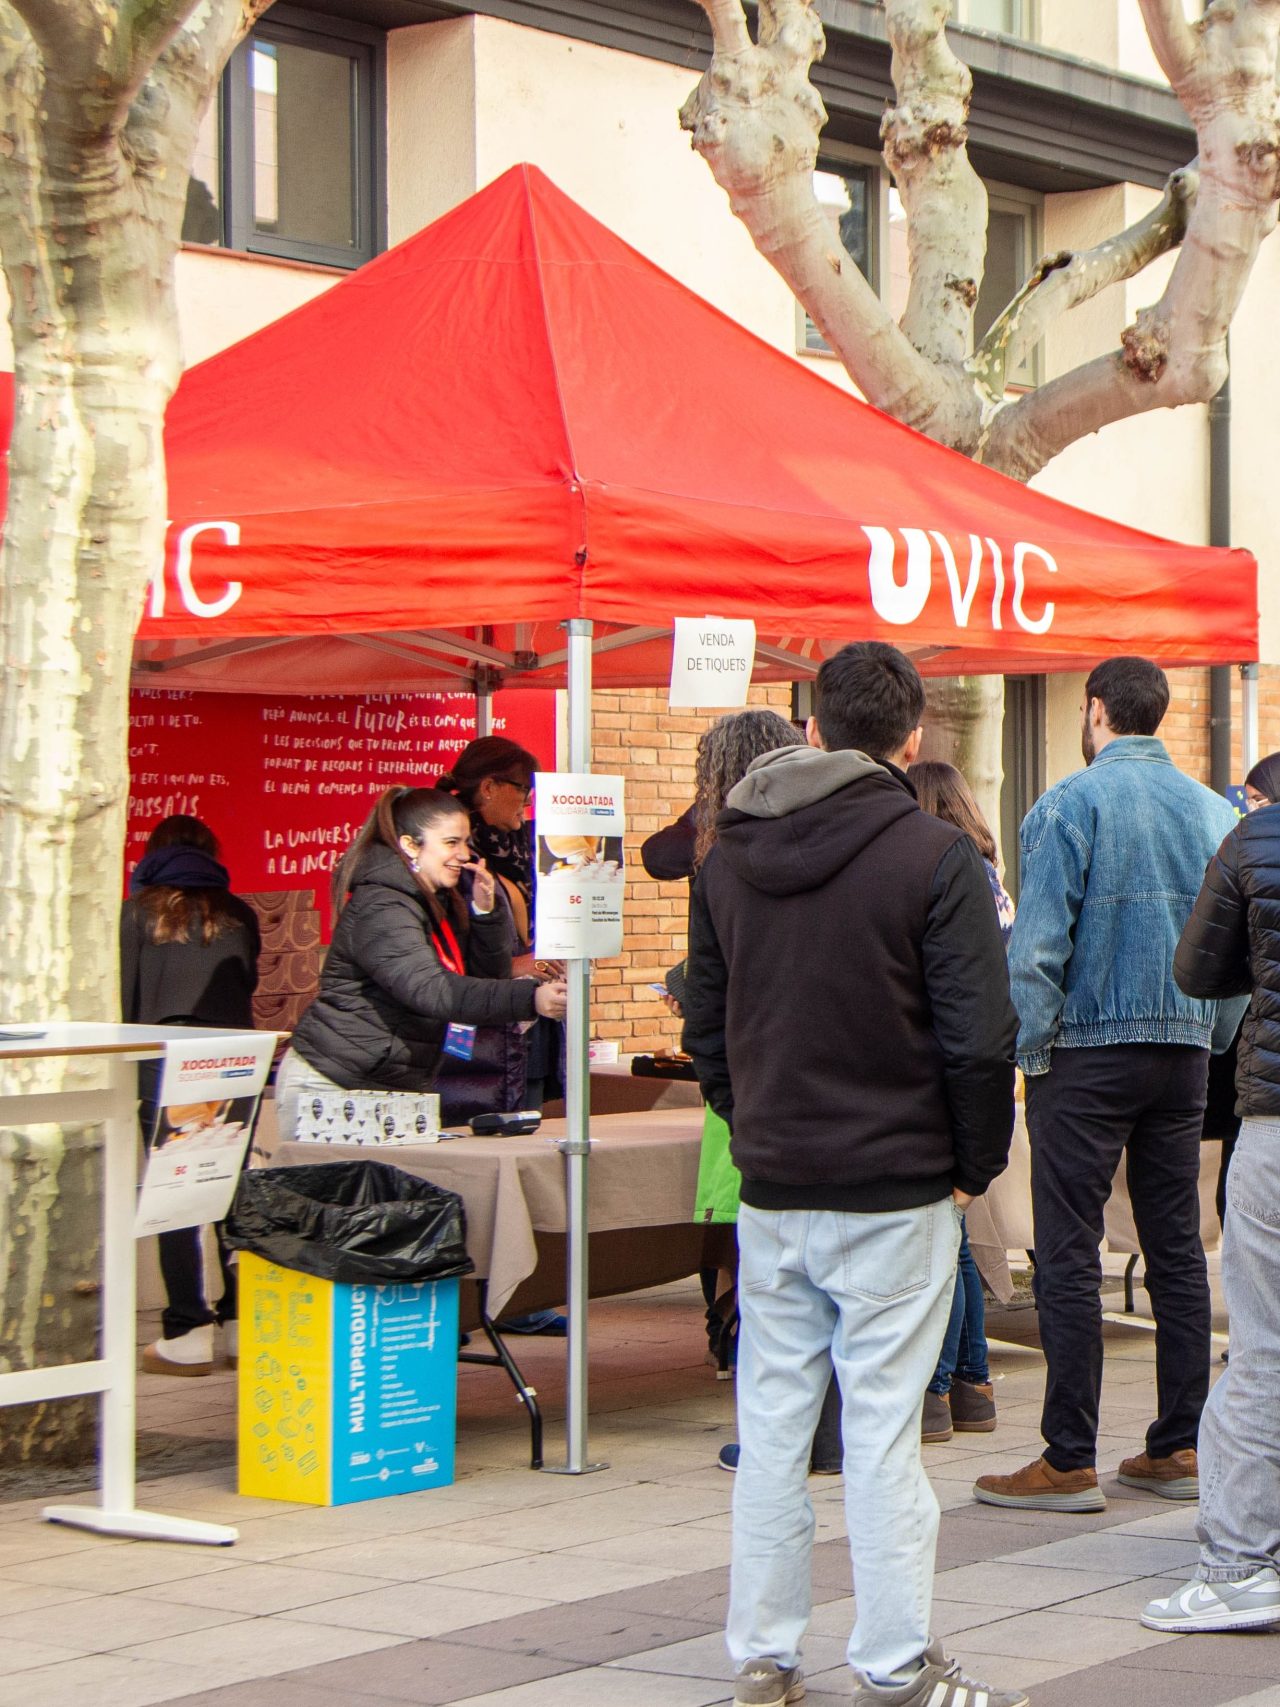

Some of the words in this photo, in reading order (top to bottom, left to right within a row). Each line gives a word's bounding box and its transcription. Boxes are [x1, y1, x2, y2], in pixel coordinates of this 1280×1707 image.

[149, 519, 243, 618] IC
[860, 525, 1058, 635] UVIC
[698, 633, 735, 646] VENDA
[687, 657, 703, 671] DE
[705, 657, 746, 673] TIQUETS
[129, 714, 155, 728] OLTA
[354, 704, 408, 734] FUTUR
[421, 716, 432, 727] EL
[459, 717, 476, 731] QUE
[274, 734, 290, 748] LES
[293, 735, 344, 751] DECISIONS
[347, 738, 364, 752] QUE
[366, 738, 379, 752] TU
[304, 759, 319, 773] DE
[187, 773, 205, 786] NO
[264, 780, 277, 793] EL
[317, 782, 364, 797] COMENÇA
[551, 795, 614, 807] XOCOLATADA
[264, 829, 285, 850] LA
[287, 822, 363, 848] UNIVERSI
[267, 858, 277, 874] A
[280, 855, 299, 875] LA
[302, 849, 345, 875] INCR
[180, 1056, 256, 1071] XOCOLATADA
